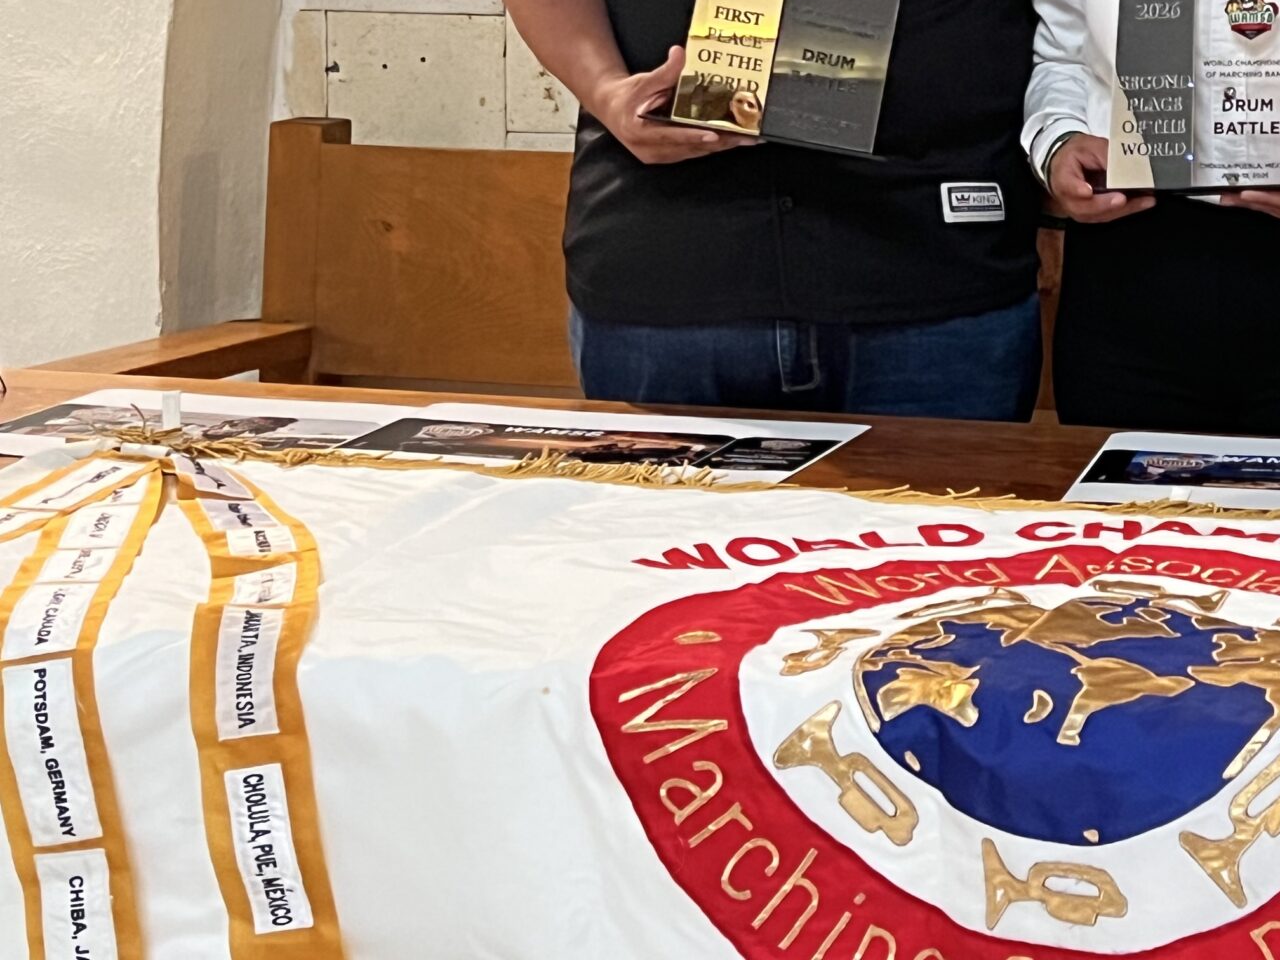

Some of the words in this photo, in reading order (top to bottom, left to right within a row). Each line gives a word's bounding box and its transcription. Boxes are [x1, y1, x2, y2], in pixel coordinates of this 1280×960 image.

[713, 5, 765, 26] FIRST
[1135, 1, 1182, 20] 2026
[705, 26, 763, 50] PLACE
[697, 48, 723, 65] OF
[726, 53, 764, 72] THE
[801, 47, 856, 71] DRUM
[1221, 98, 1274, 112] DRUM
[1213, 121, 1280, 135] BATTLE
[1120, 141, 1187, 158] WORLD
[630, 523, 985, 570] WORLD
[783, 561, 1011, 606] World
[235, 652, 257, 730] INDONESIA
[32, 667, 55, 755] POTSDAM,
[44, 757, 77, 838] GERMANY
[242, 772, 272, 844] CHOLULA,
[617, 666, 950, 960] Marchin
[252, 843, 279, 878] PUE,
[68, 874, 88, 940] CHIBA,
[261, 874, 294, 928] MÉXICO
